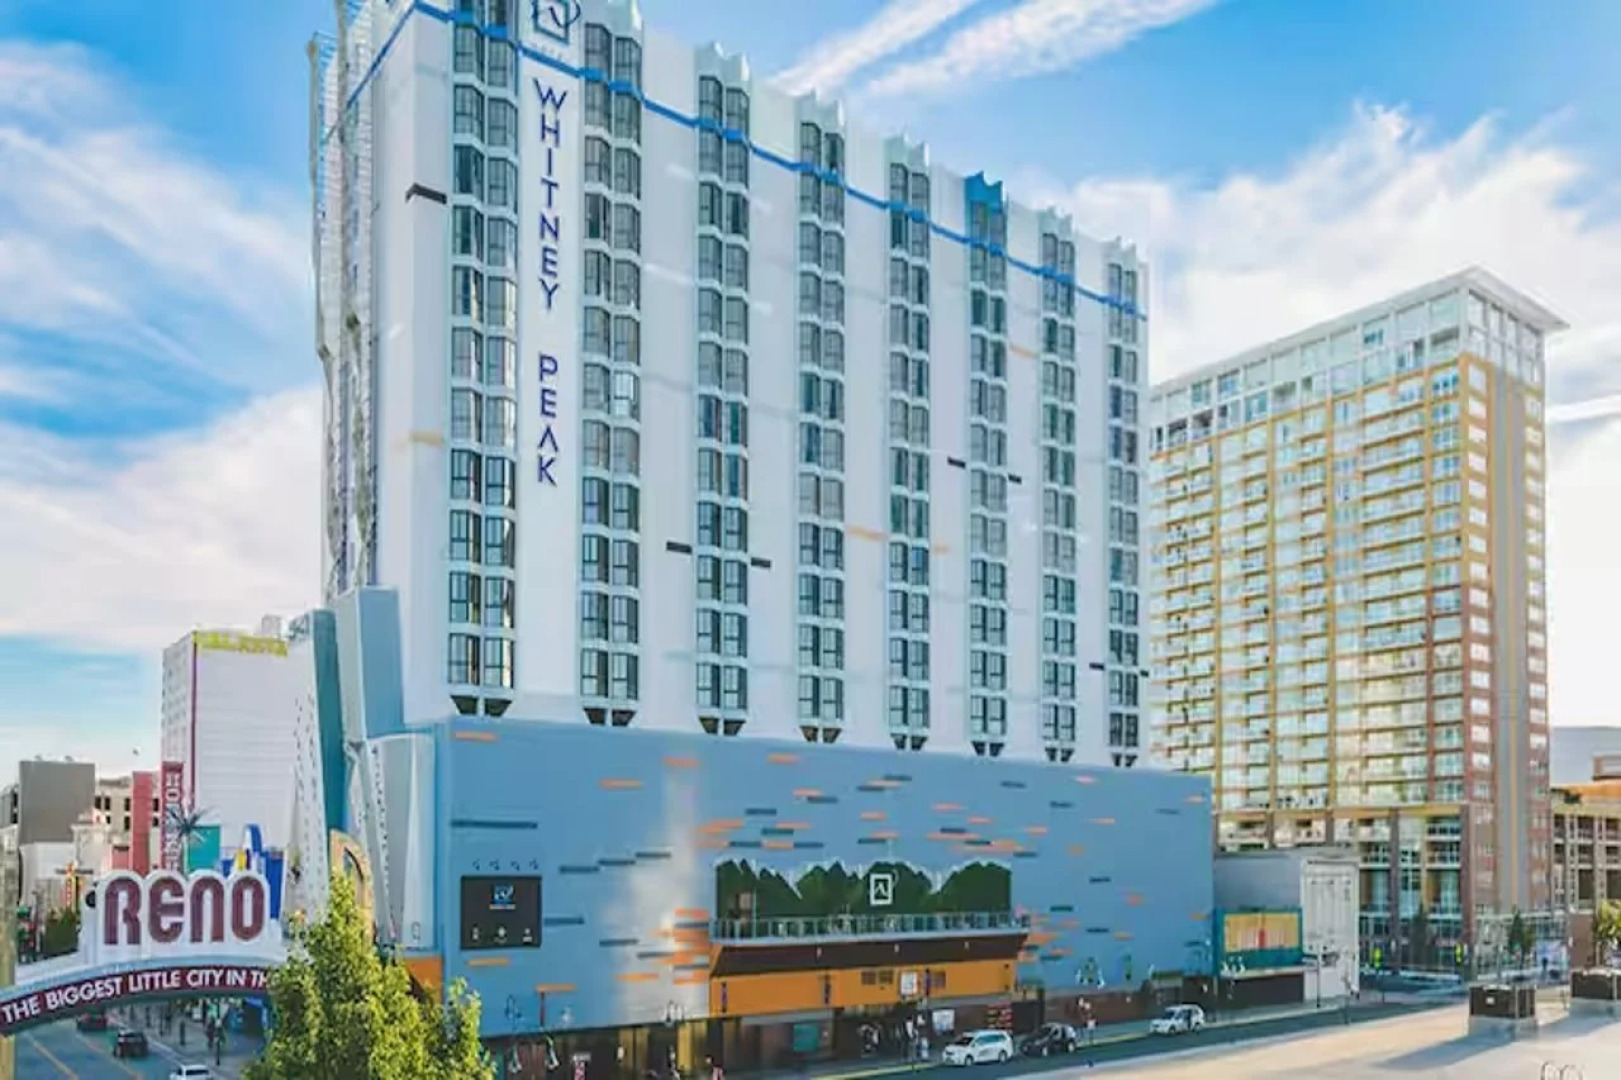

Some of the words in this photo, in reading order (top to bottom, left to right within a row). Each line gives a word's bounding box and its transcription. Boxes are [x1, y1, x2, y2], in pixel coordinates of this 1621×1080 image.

[532, 77, 567, 309] WHITNEY
[538, 351, 559, 487] PEAK
[103, 876, 265, 945] RENO
[2, 996, 41, 1023] THE
[45, 977, 123, 1010] BIGGEST
[128, 970, 181, 993] LITTLE
[186, 969, 224, 988] CITY
[226, 969, 247, 986] IN
